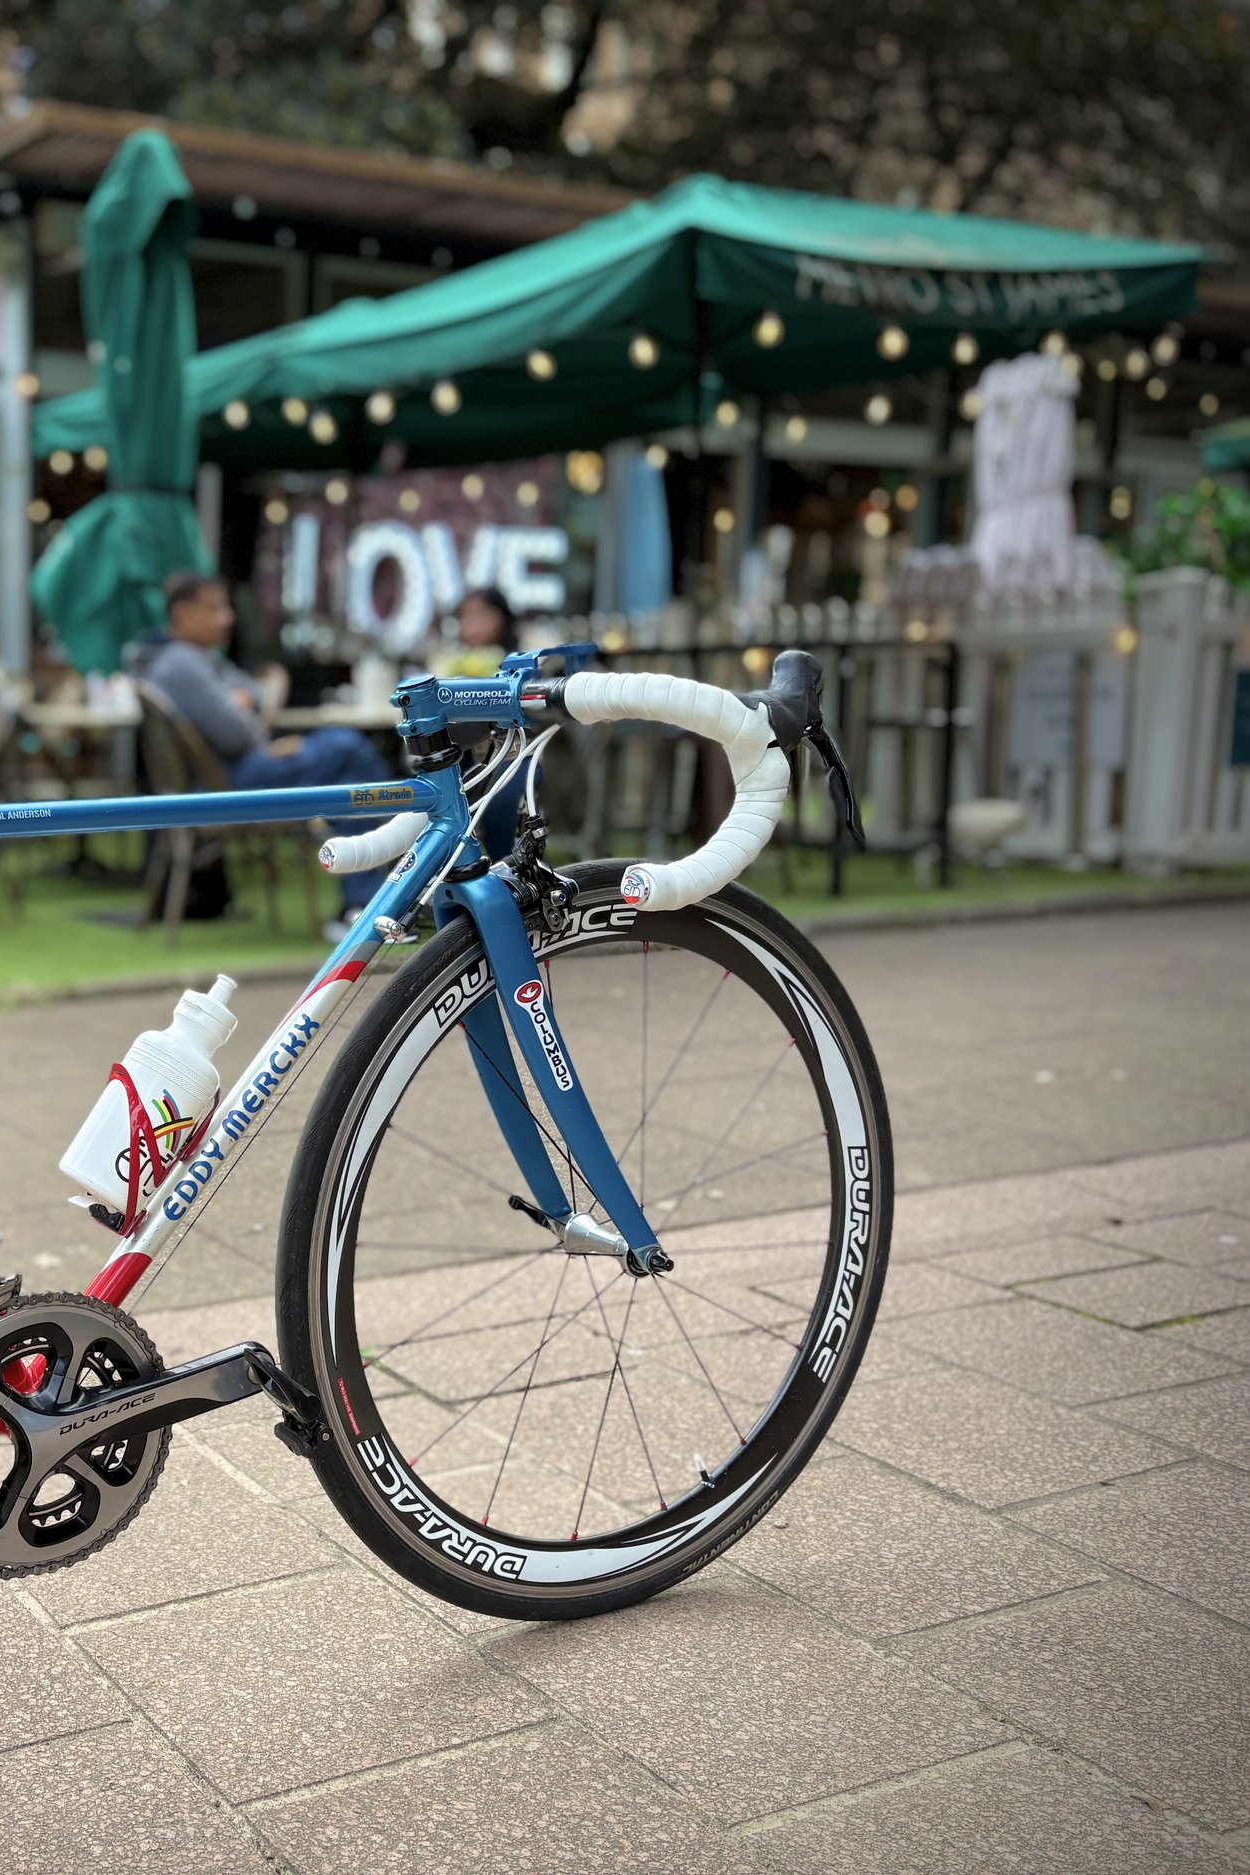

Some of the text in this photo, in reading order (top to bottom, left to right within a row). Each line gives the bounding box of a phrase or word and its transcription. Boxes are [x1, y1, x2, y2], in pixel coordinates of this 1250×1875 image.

[280, 513, 570, 656] LOVE
[453, 689, 512, 699] MOTOROLA
[453, 698, 511, 707] CYCLING TEAM
[8, 808, 52, 820] ANDERSON
[529, 1000, 570, 1088] COLUMBUS
[162, 1013, 321, 1221] EDDY MERCKX
[811, 1146, 871, 1384] DURA-ACE
[59, 1392, 156, 1436] DURA-ACE
[356, 1435, 528, 1581] DURA-ACE
[682, 1489, 780, 1574] CONTINENTAL
